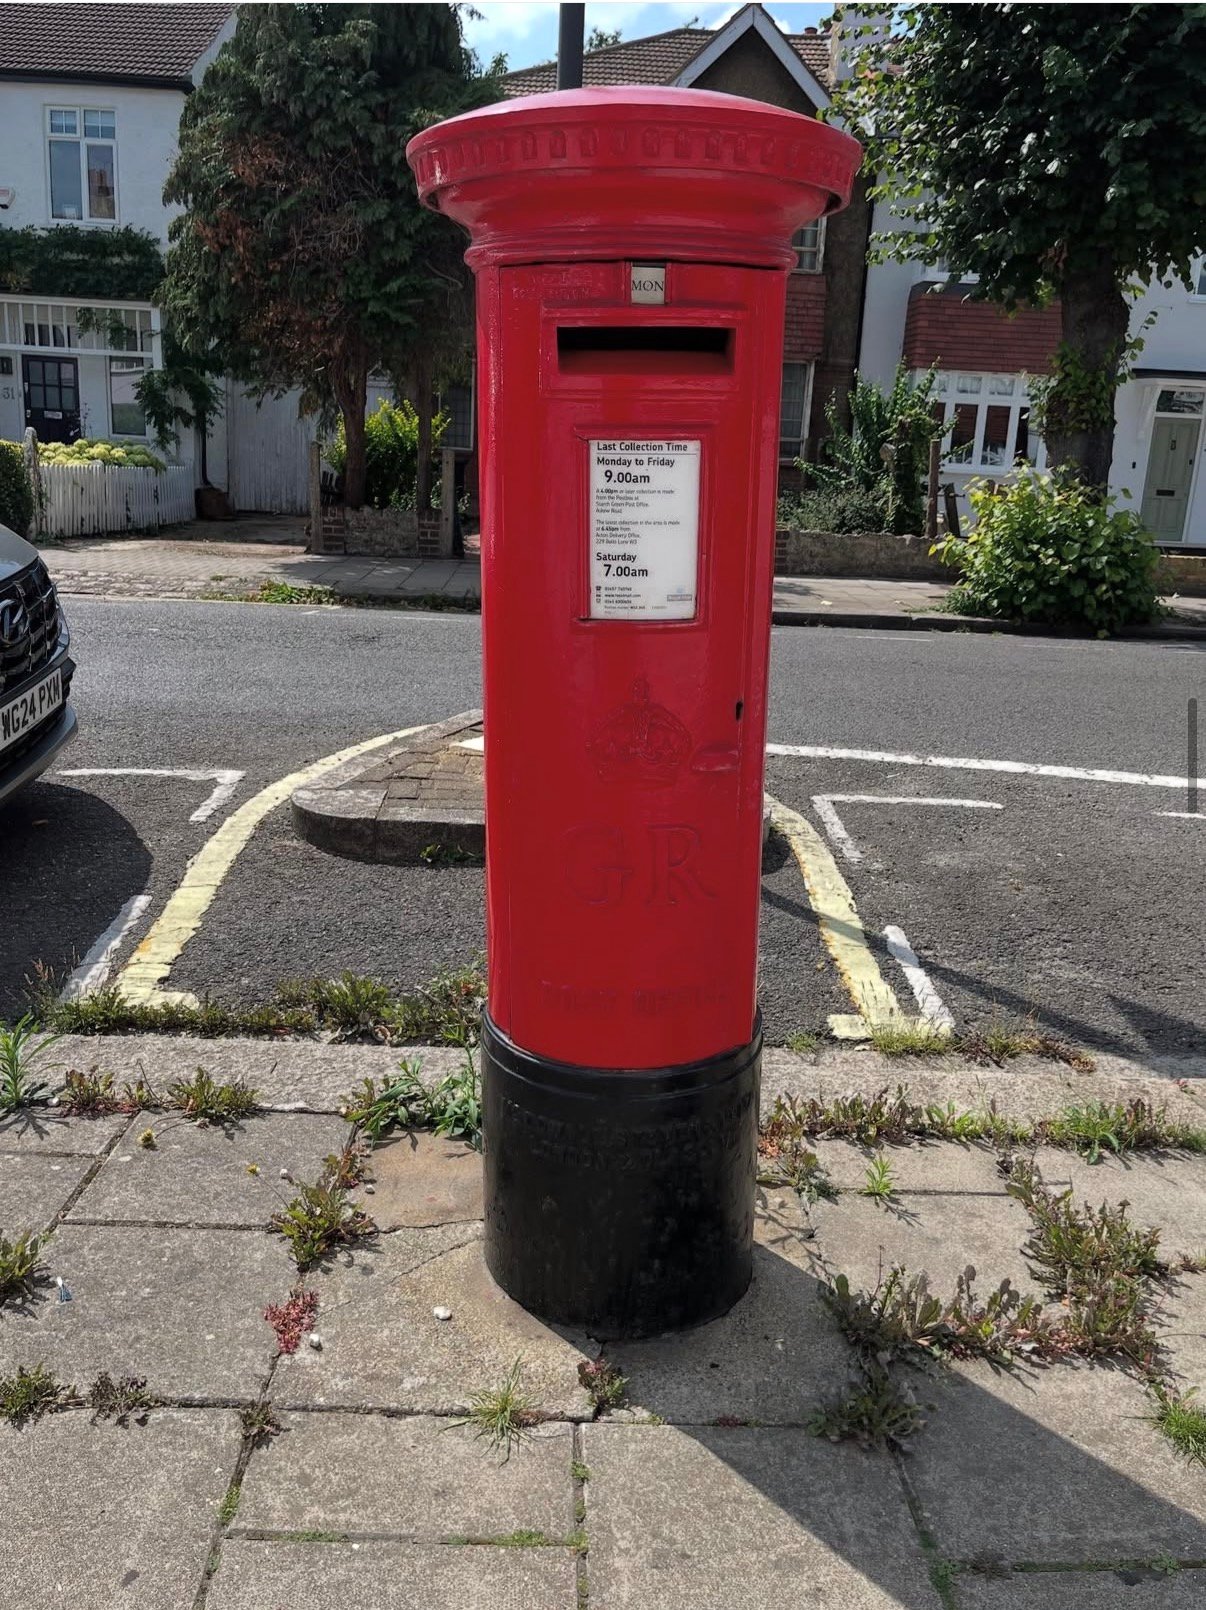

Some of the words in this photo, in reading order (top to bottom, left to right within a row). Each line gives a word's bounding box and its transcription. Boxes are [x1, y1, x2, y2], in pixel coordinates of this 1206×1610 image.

[632, 280, 664, 292] MON
[2, 387, 15, 400] 31
[597, 442, 616, 451] Last
[619, 442, 663, 451] Collection
[665, 443, 688, 452] Time
[597, 457, 632, 467] Monday
[635, 458, 644, 466] to
[647, 458, 675, 468] Friday
[604, 469, 650, 484] 9.00am
[596, 552, 637, 563] Saturday
[603, 564, 648, 577] 7.00am
[1, 692, 36, 741] WG24
[39, 673, 60, 714] PXM
